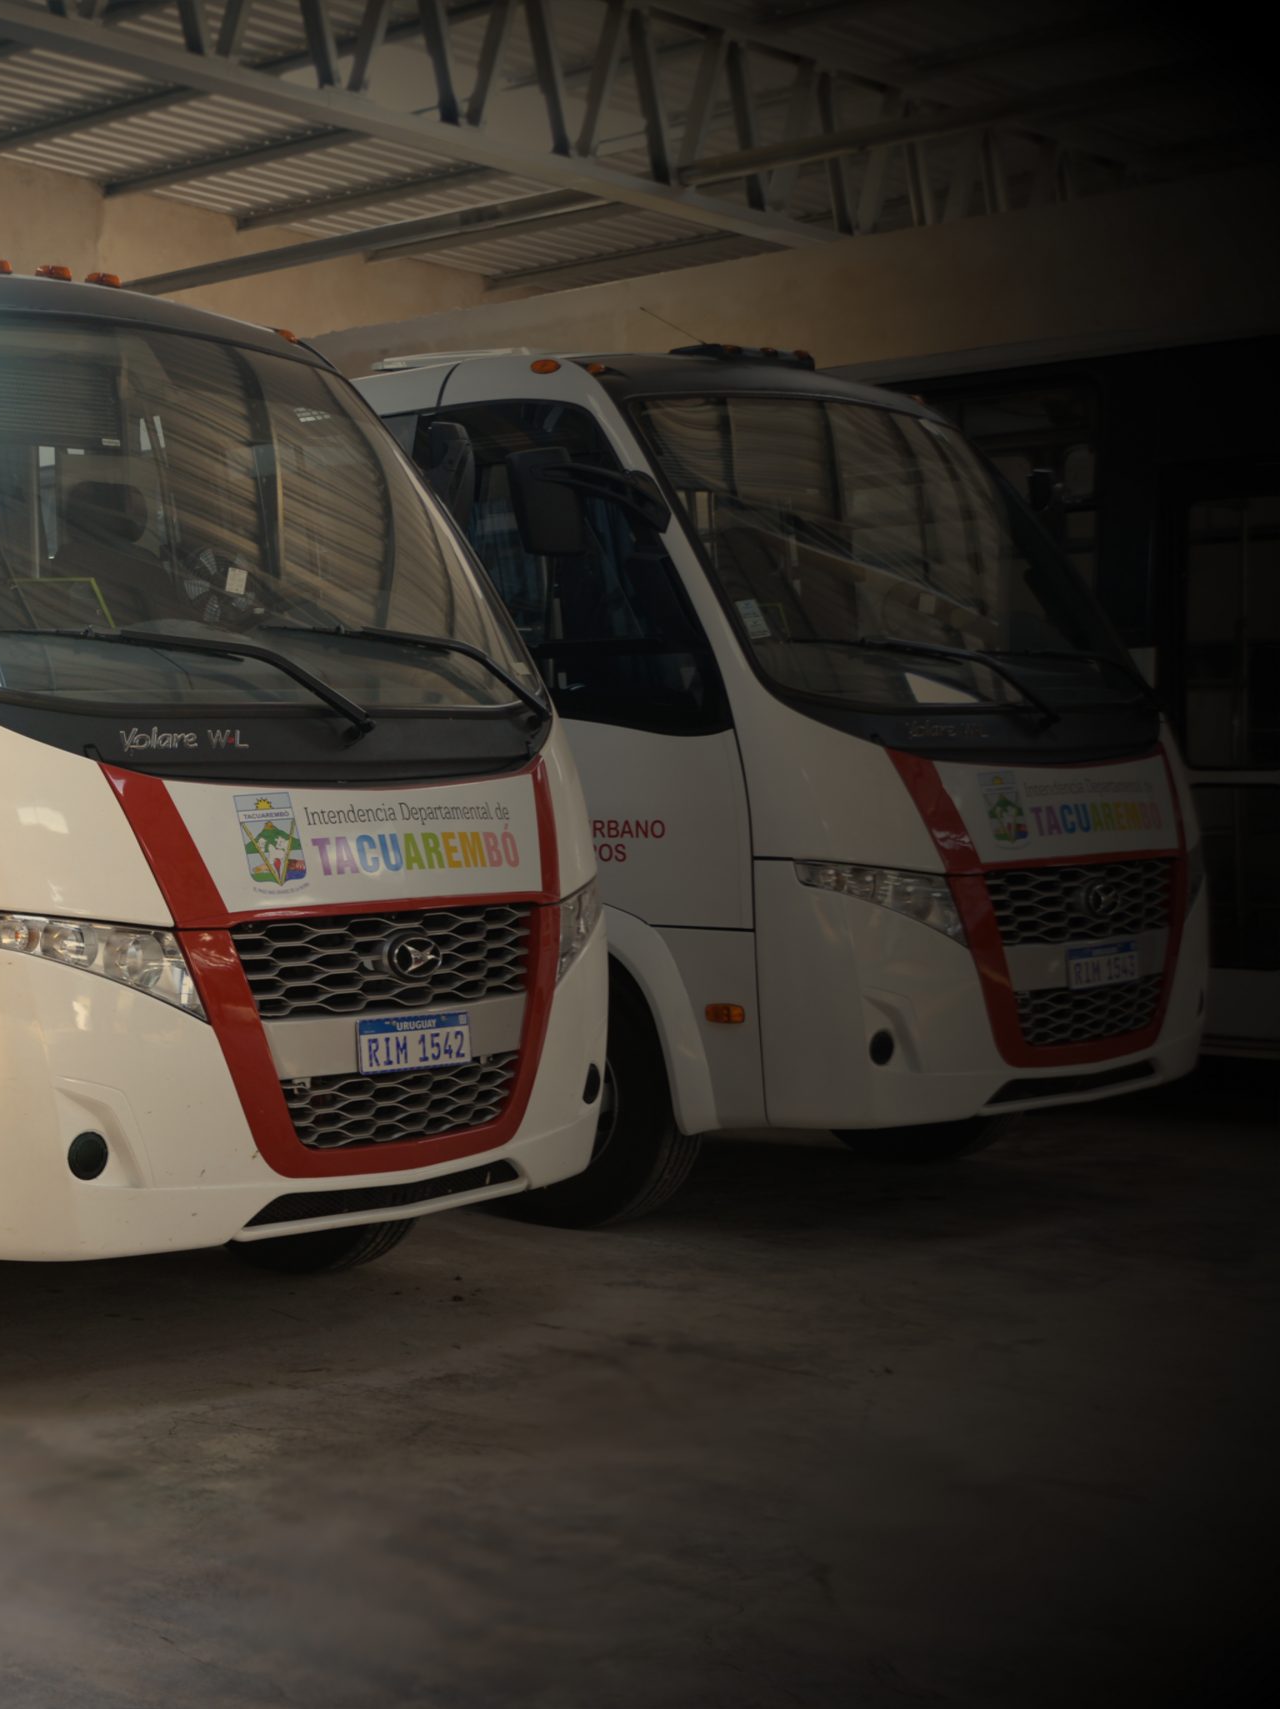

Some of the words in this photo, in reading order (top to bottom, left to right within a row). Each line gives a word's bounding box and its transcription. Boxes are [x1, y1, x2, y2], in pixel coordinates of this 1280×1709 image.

[119, 726, 198, 752] Volare
[304, 803, 397, 826] Intendencia
[399, 801, 493, 826] Departamental
[495, 802, 510, 821] de
[589, 819, 666, 839] RBANO
[311, 823, 520, 876] TACUAREMBÓ
[396, 1019, 437, 1031] URUGUAY
[368, 1036, 408, 1067] RIM
[419, 1031, 465, 1063] 1542
